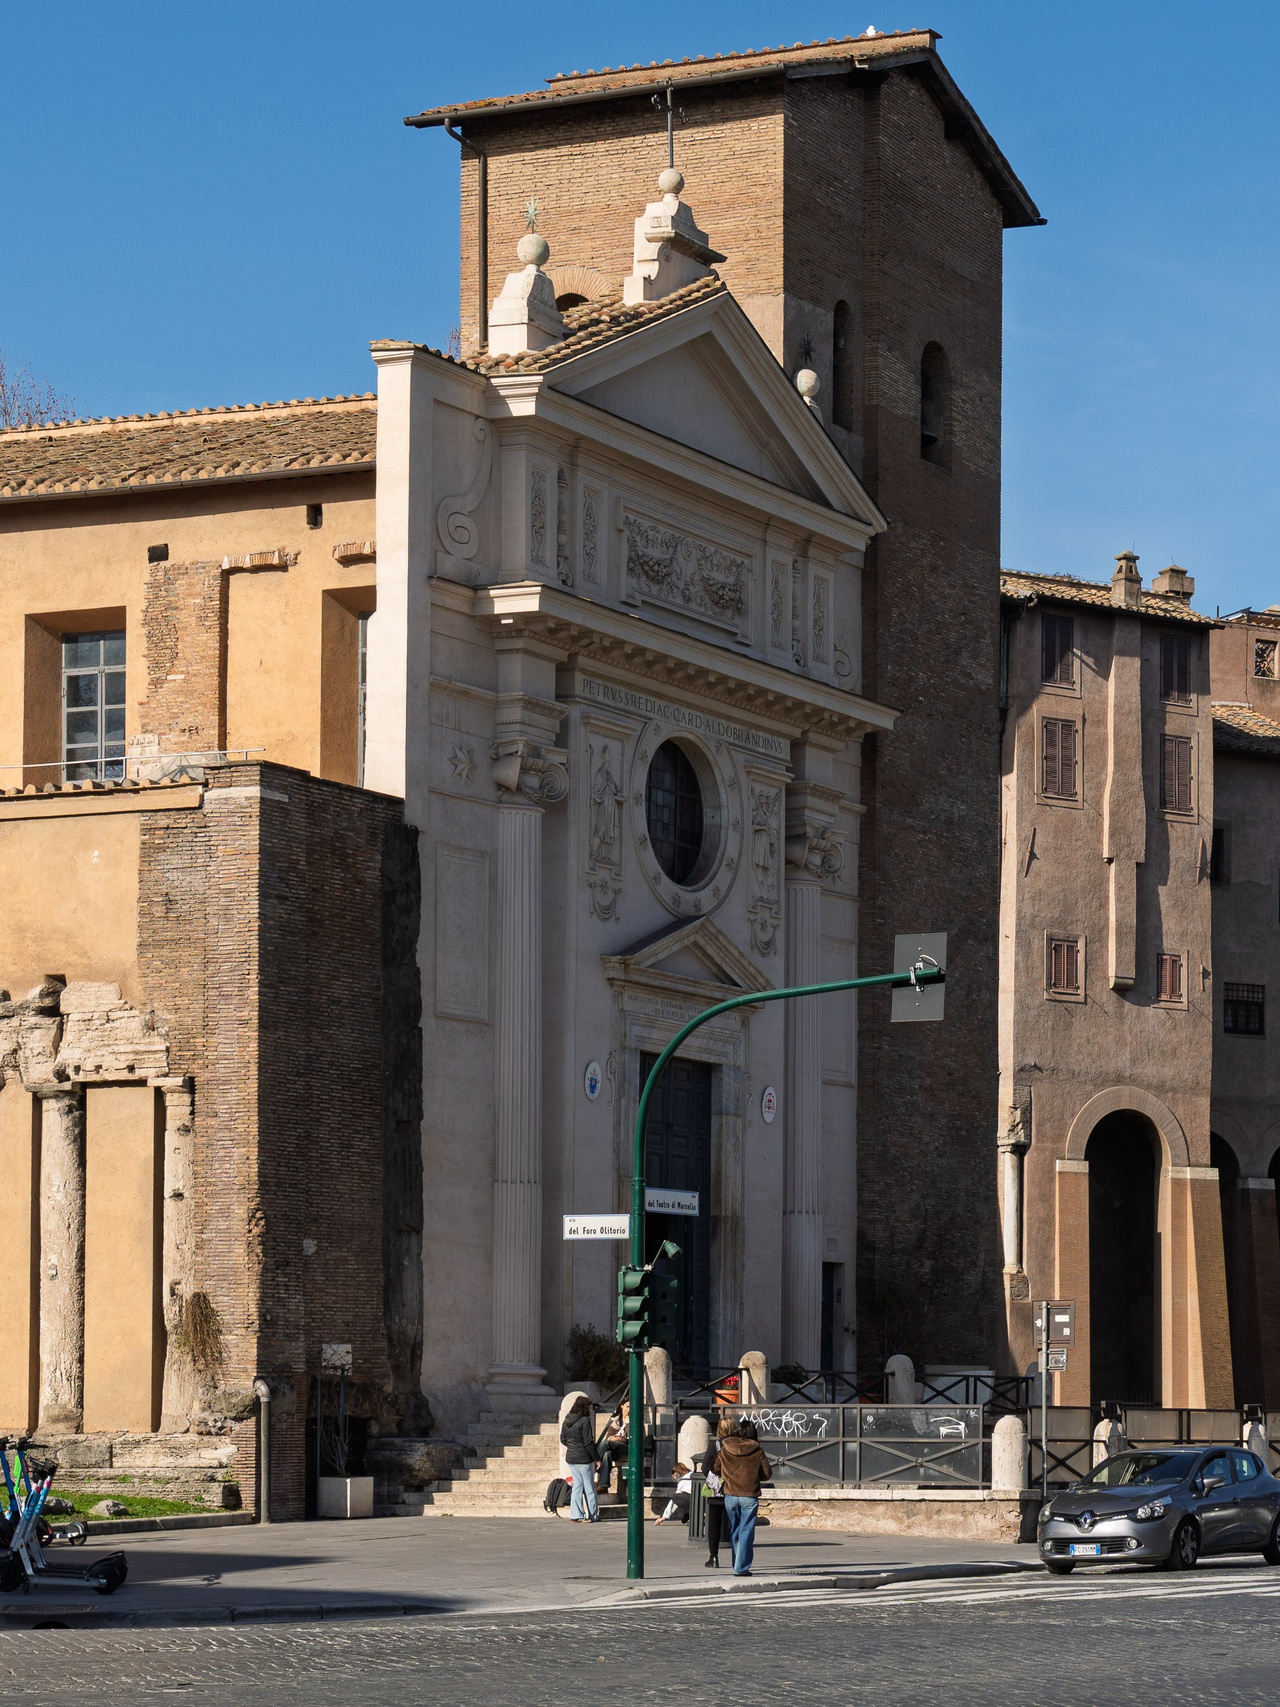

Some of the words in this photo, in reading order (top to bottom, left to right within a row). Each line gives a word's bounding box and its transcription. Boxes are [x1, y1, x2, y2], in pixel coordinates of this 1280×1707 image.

[647, 1200, 655, 1208] del
[671, 1201, 677, 1209] di
[677, 1201, 696, 1211] Marcello
[569, 1226, 579, 1235] del
[582, 1226, 597, 1235] Foro
[599, 1226, 626, 1235] Olitorio
